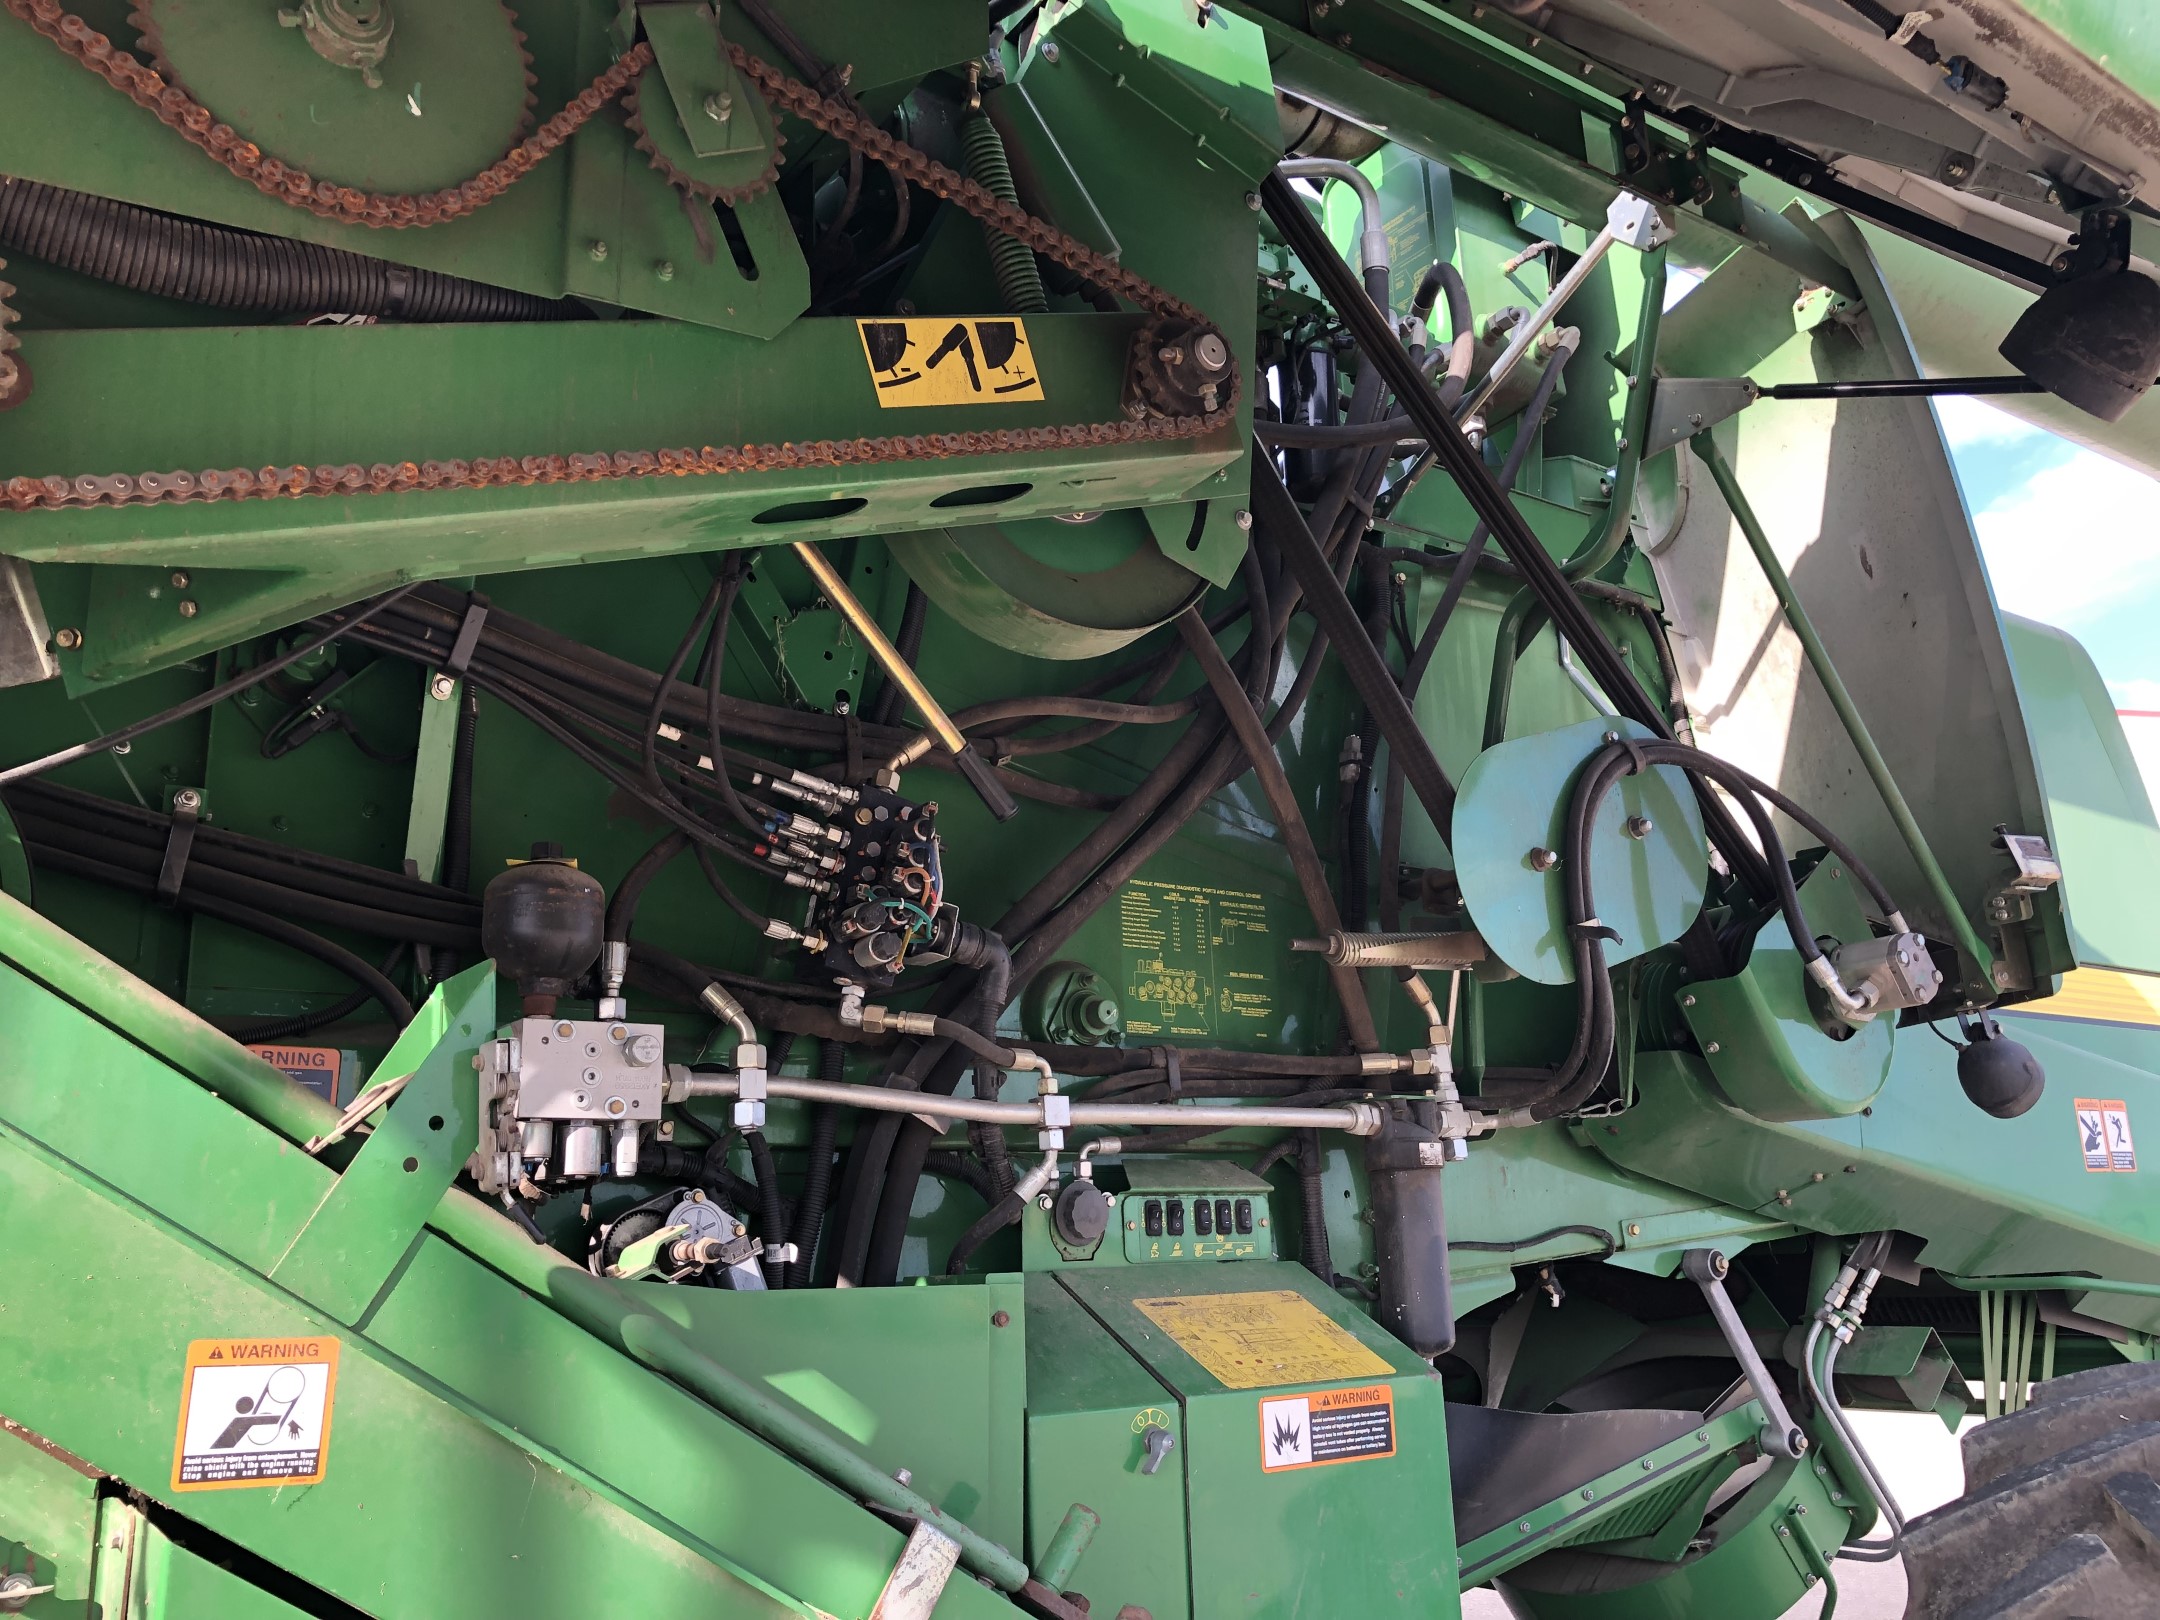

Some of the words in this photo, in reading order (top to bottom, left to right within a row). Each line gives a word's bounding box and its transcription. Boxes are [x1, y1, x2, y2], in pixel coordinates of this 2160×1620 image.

[261, 1051, 325, 1066] RNING
[231, 1343, 319, 1359] WARNING
[1332, 1390, 1380, 1404] WARNING
[230, 1462, 245, 1470] with
[261, 1460, 285, 1468] engine
[287, 1459, 316, 1467] running.
[182, 1472, 201, 1480] Stop
[208, 1471, 236, 1479] engine
[263, 1467, 292, 1475] remove
[299, 1466, 315, 1474] key.
